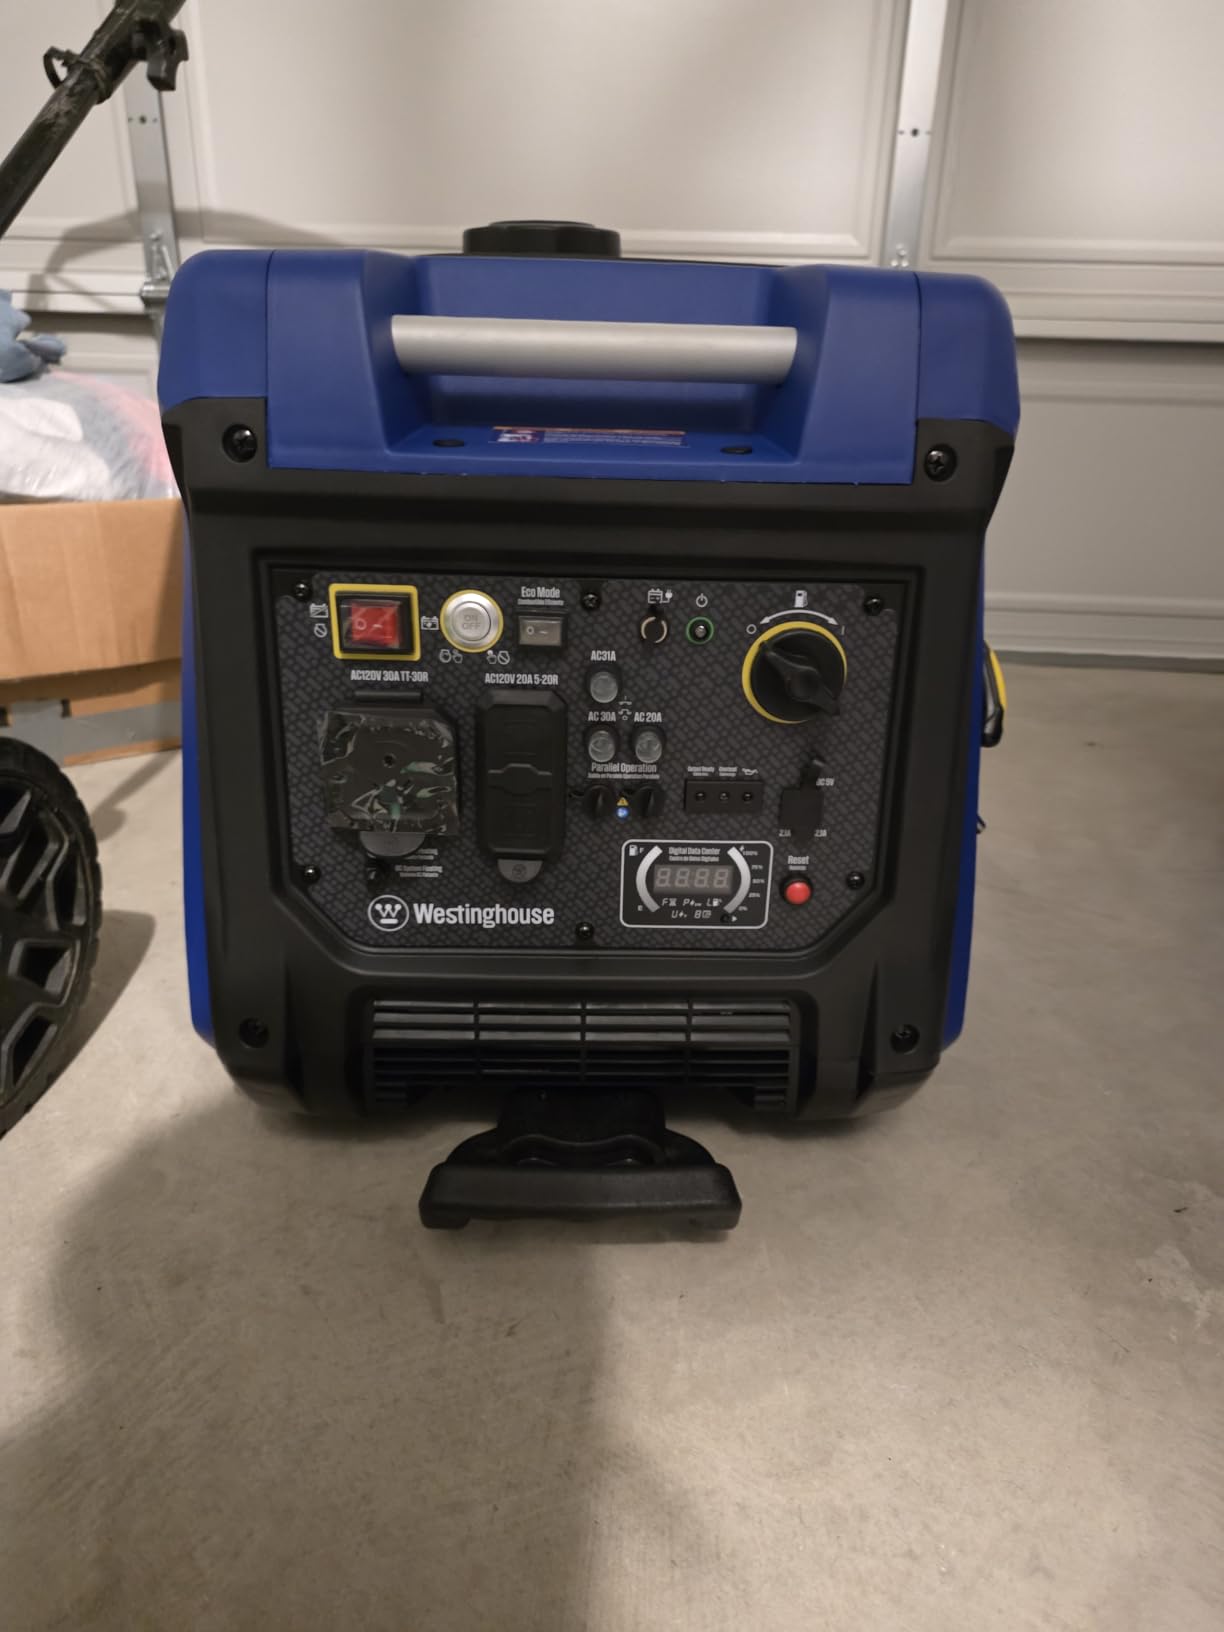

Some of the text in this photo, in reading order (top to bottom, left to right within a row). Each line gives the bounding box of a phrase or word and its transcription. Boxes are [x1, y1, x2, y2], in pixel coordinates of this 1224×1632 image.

[521, 586, 561, 598] Eco Mode
[590, 650, 616, 662] AC31A
[350, 669, 429, 682] AC120V 30A TT-30R
[484, 672, 559, 686] AC120V 20A 5-20R
[587, 711, 617, 722] AC 30A
[633, 712, 662, 723] AC 20A
[591, 762, 657, 774] Parallel Operation
[668, 847, 720, 856] Digital Data Center
[787, 855, 809, 865] Reset
[413, 903, 554, 929] Westinghouse
